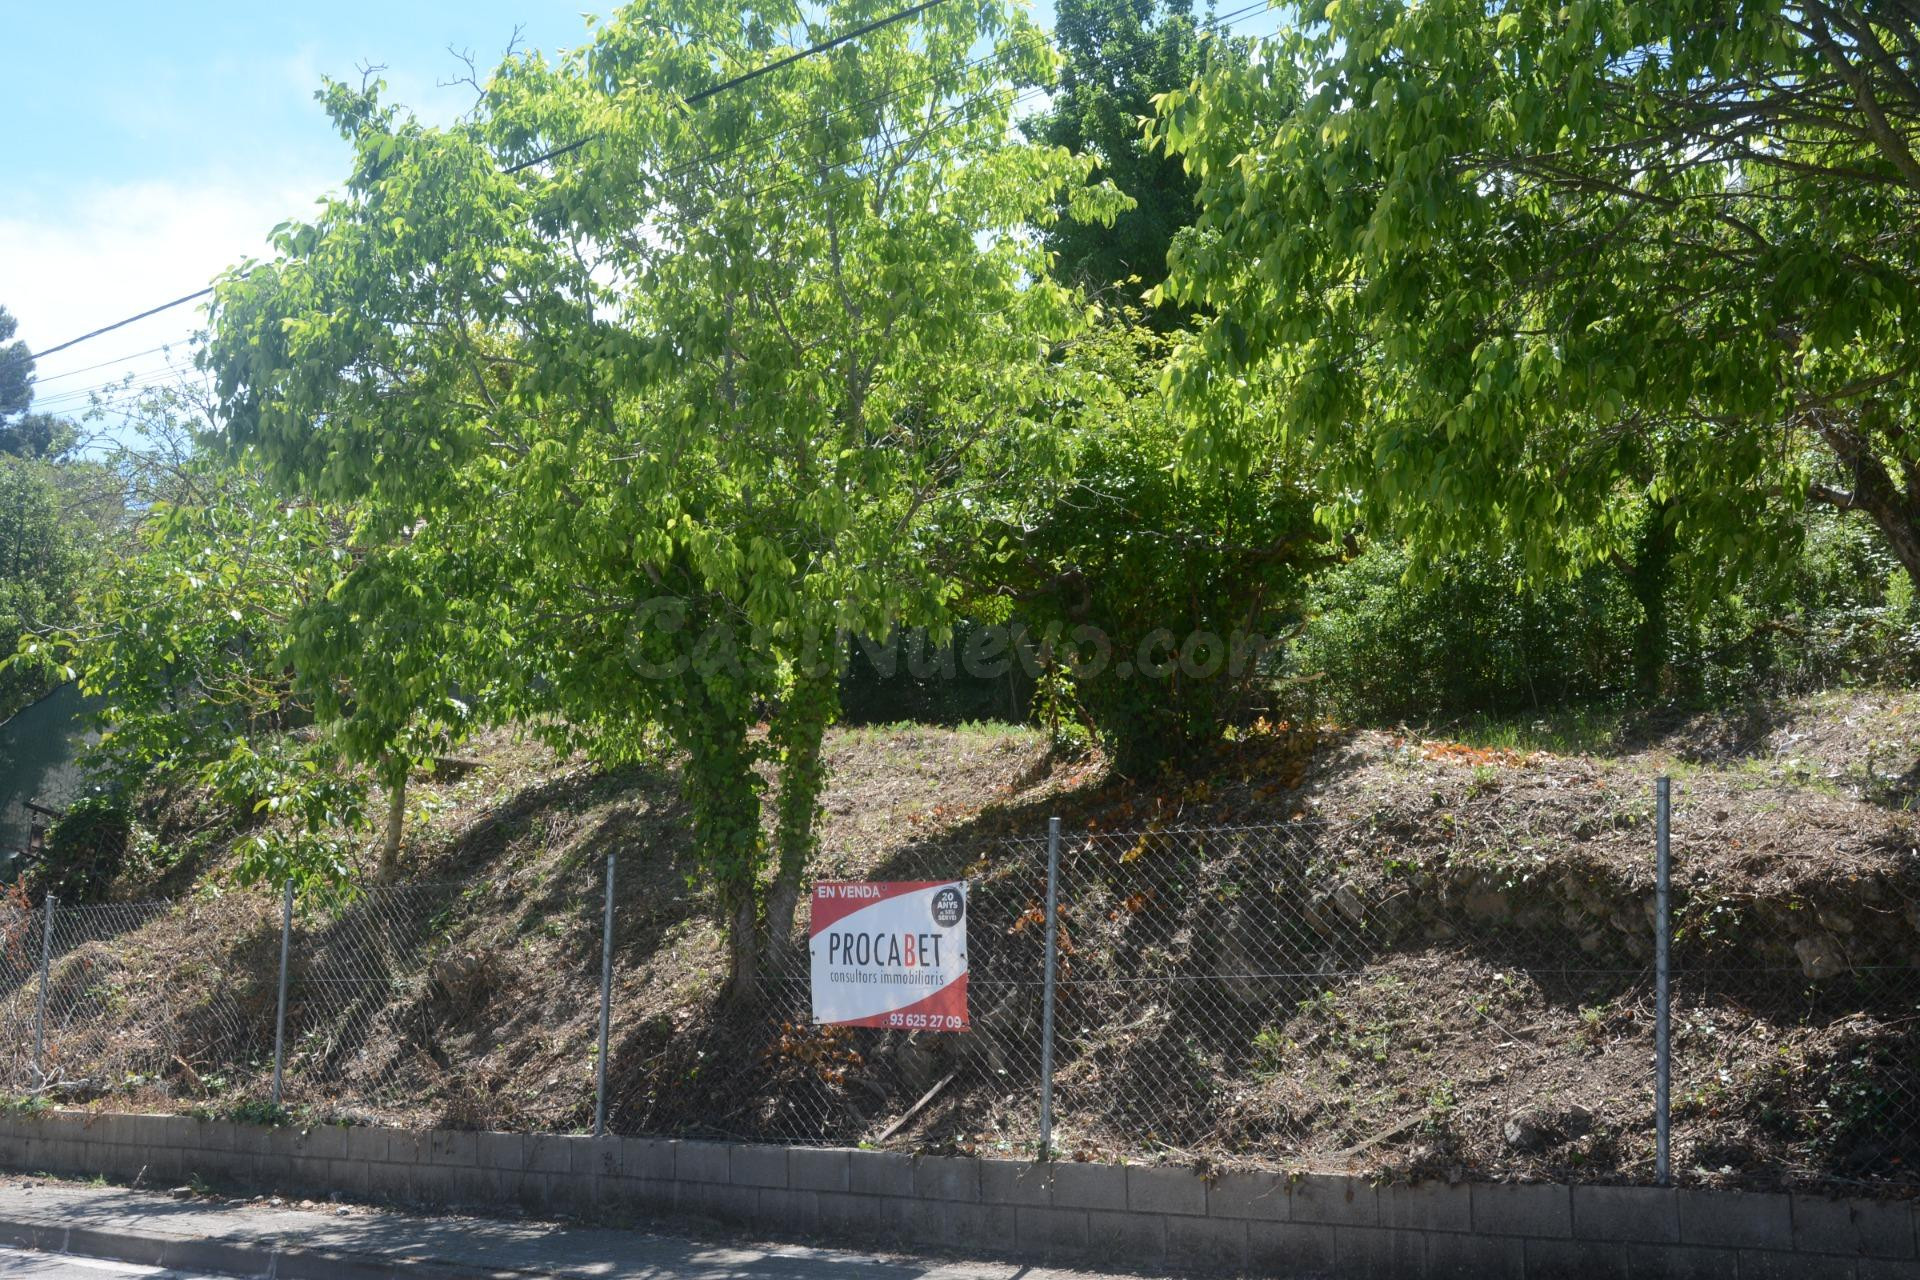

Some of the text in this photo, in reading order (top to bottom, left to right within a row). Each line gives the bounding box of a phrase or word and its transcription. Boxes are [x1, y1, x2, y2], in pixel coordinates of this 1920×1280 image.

[818, 885, 881, 898] EN VENDA
[942, 892, 954, 901] 20
[937, 901, 958, 909] ANYS
[829, 932, 943, 967] PROCABET
[830, 969, 944, 986] consultors immobiliaris
[889, 1013, 962, 1028] 93 625 27 09
